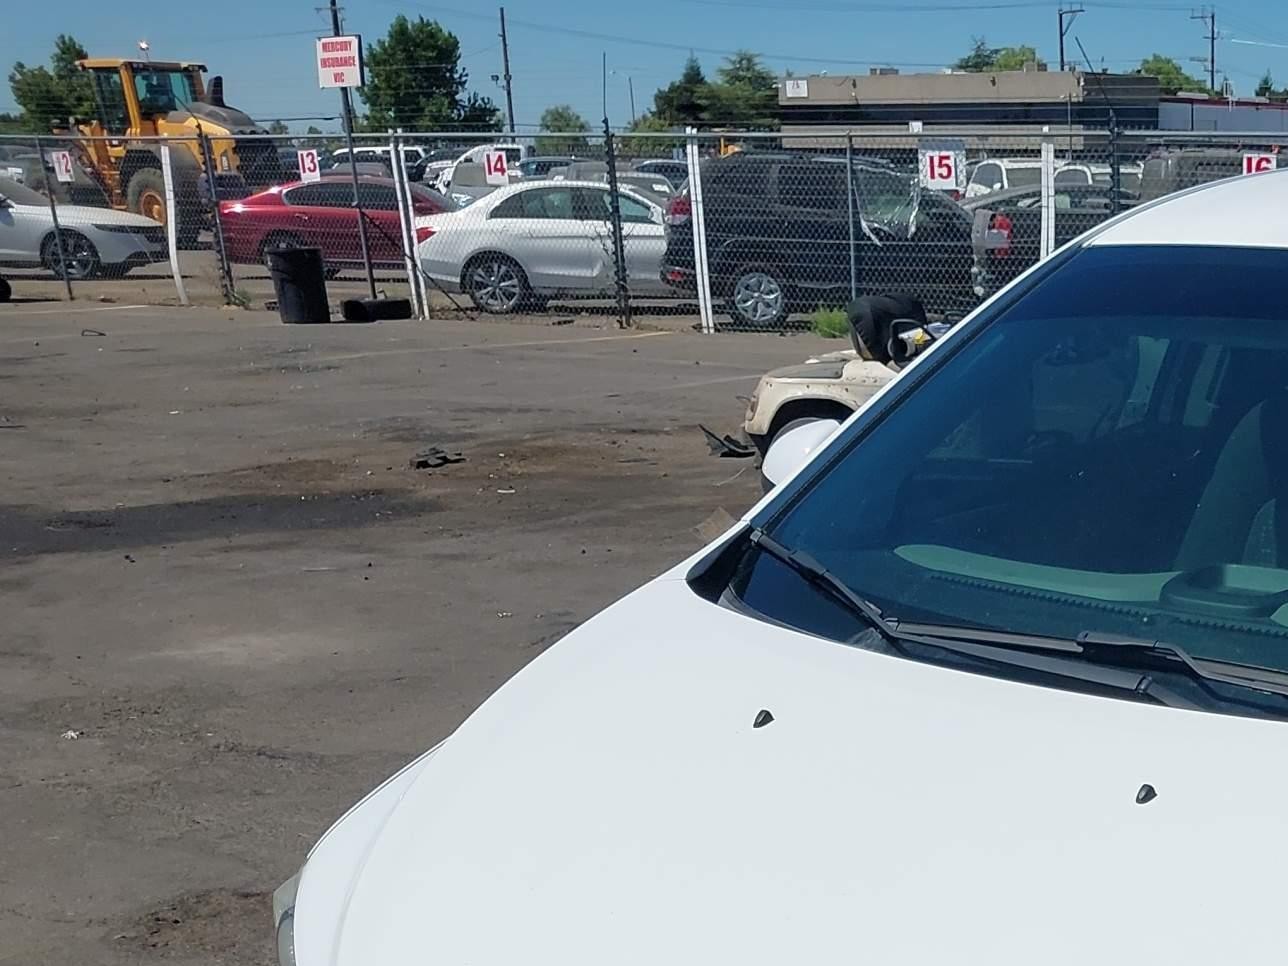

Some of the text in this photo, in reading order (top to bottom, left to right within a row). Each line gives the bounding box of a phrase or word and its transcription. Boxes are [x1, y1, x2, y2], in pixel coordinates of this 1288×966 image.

[322, 41, 353, 53] MERCURY
[320, 56, 356, 69] INSURANCE
[333, 72, 345, 83] VIC
[300, 151, 317, 174] 13
[486, 151, 506, 176] 14
[928, 155, 952, 180] 15
